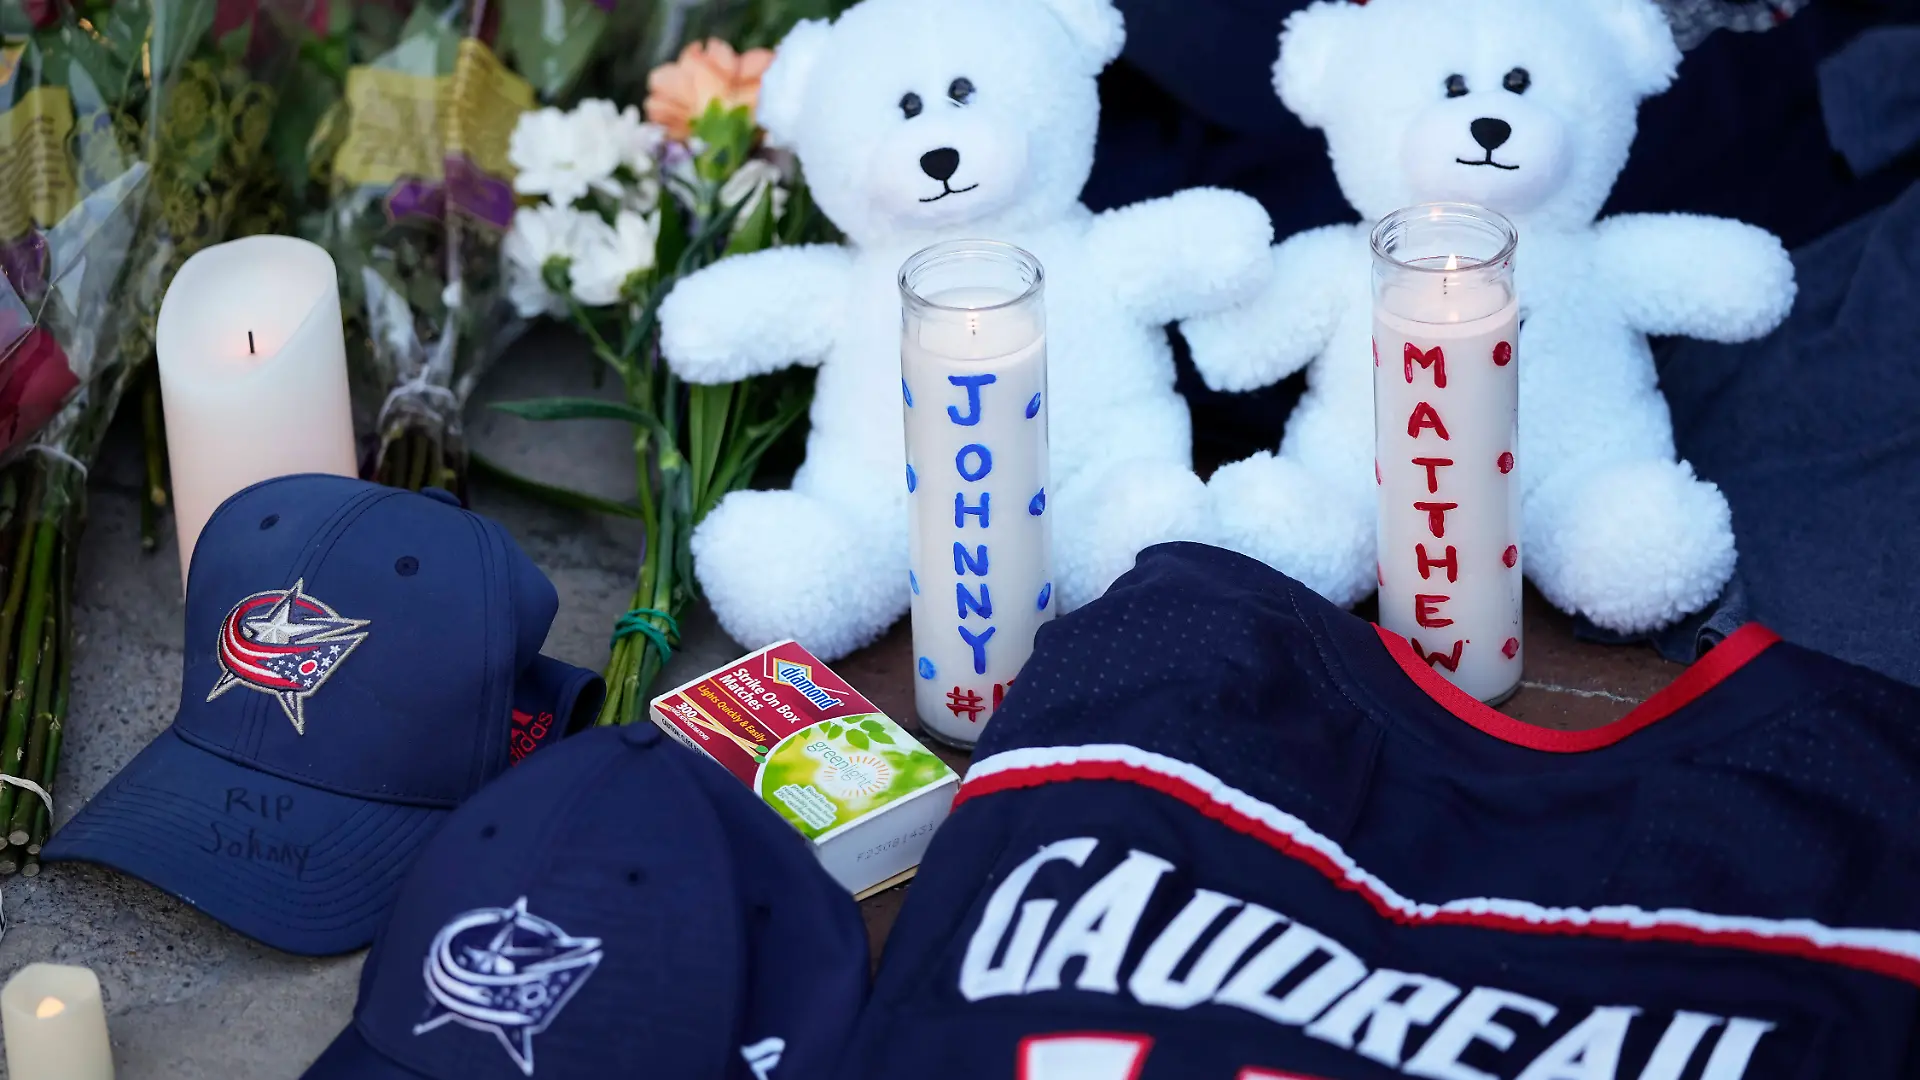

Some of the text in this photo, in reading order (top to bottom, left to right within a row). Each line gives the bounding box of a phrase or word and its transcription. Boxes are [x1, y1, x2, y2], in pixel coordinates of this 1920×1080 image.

[947, 373, 997, 675] JOHNNY
[1404, 341, 1463, 672] MATTHEW
[676, 702, 698, 718] 300
[698, 685, 767, 742] Lights Quickly & Easily
[719, 674, 763, 711] Matches
[733, 668, 801, 724] Strike On Box
[780, 667, 840, 710] diamond
[511, 711, 553, 768] didas
[806, 741, 872, 789] greenlight
[226, 787, 294, 822] RIP
[202, 821, 310, 881] Johnny
[958, 837, 1777, 1080] GAUDREAU
